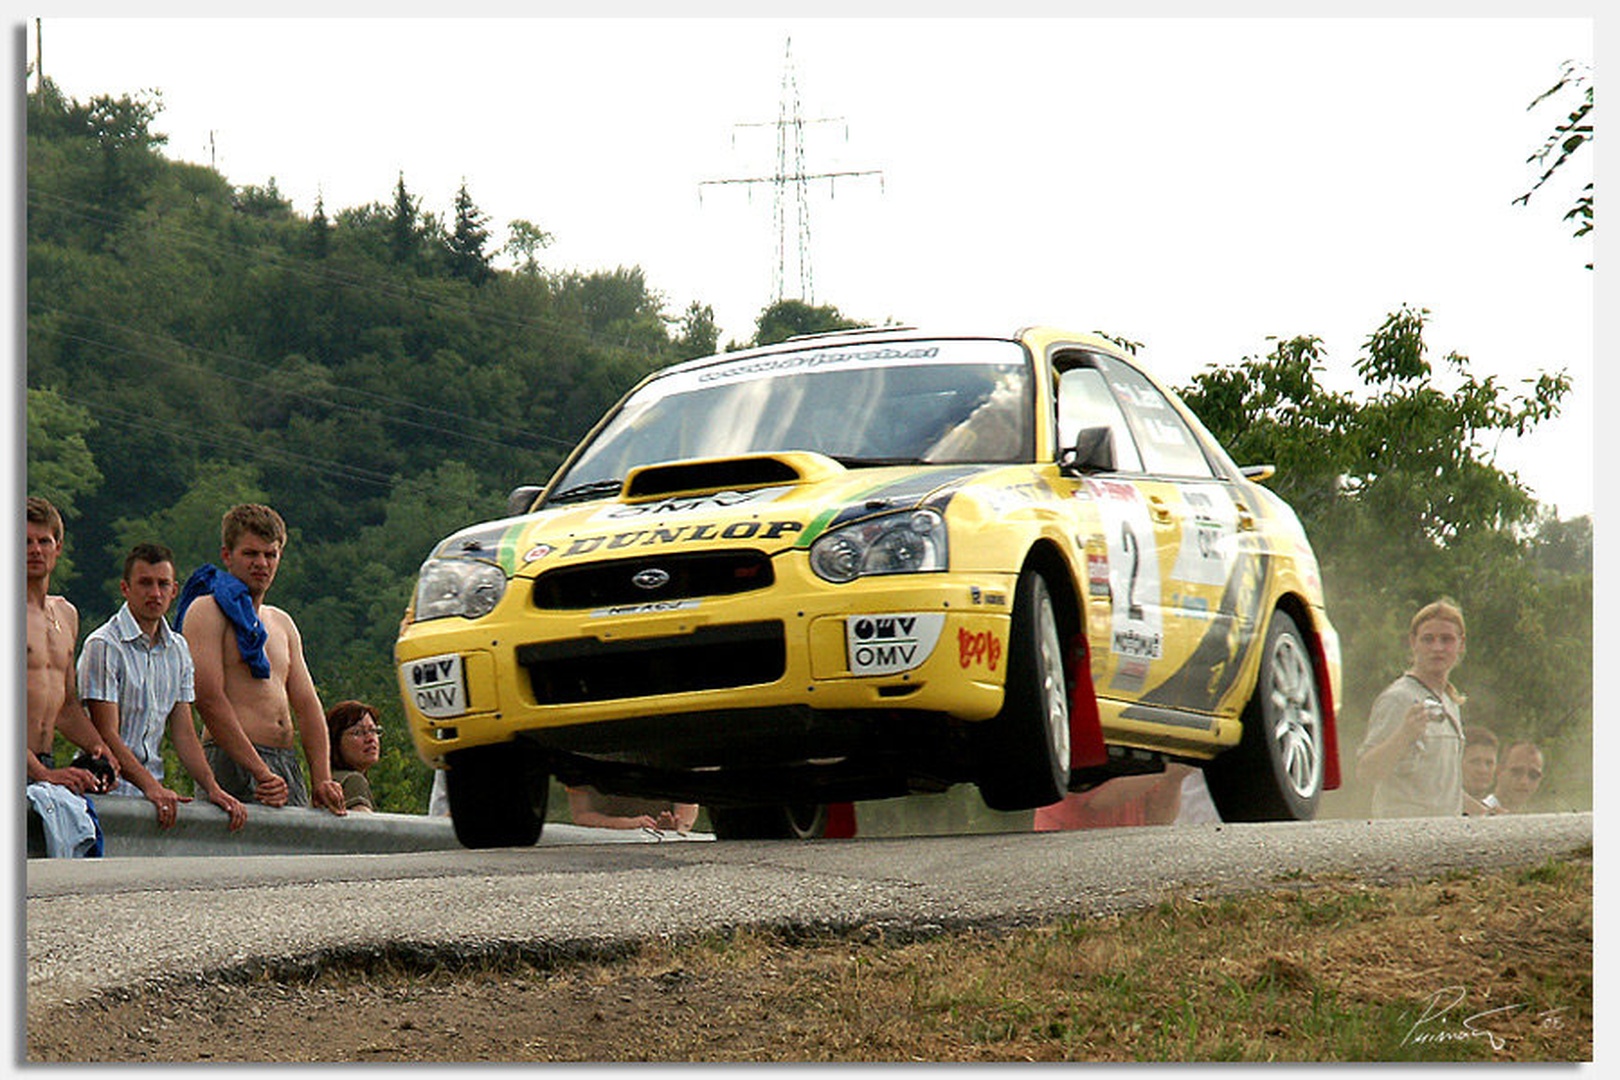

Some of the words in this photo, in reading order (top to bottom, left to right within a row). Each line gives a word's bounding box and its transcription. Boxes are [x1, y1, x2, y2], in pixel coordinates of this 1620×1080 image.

[559, 520, 804, 558] DUNLOP
[1120, 520, 1145, 621] 2
[855, 644, 918, 667] OMV
[415, 687, 457, 711] OMV
